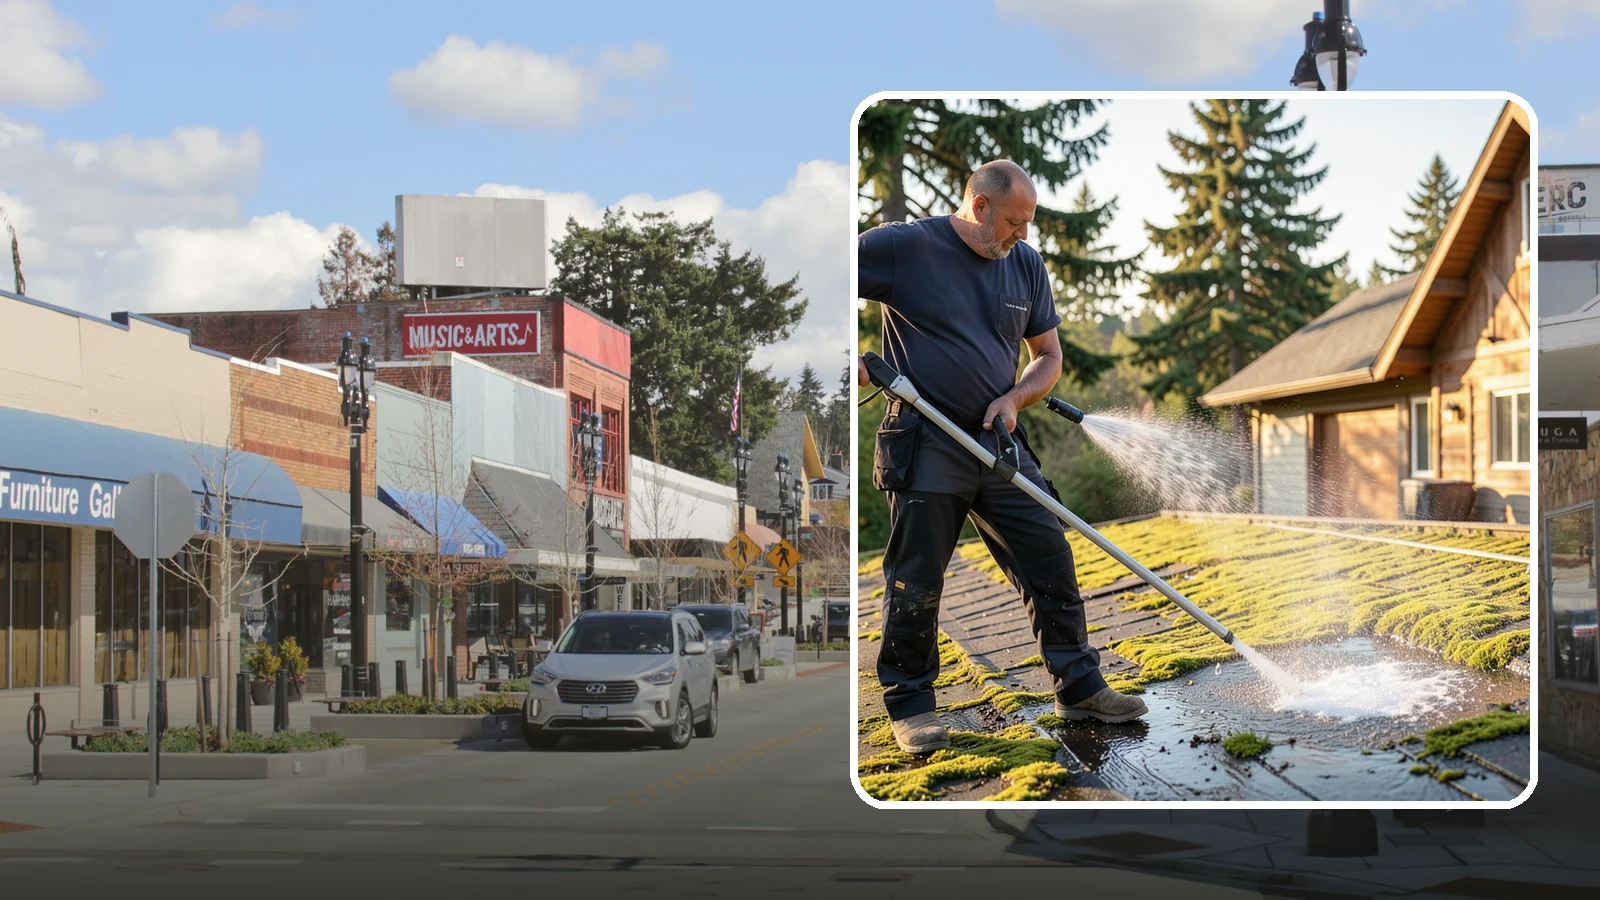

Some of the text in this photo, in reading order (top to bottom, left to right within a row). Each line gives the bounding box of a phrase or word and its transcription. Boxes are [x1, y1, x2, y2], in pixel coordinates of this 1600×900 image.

[409, 323, 519, 348] MUSIC&ARTS
[0, 472, 79, 515] Furniture
[453, 563, 480, 574] SUSHI
